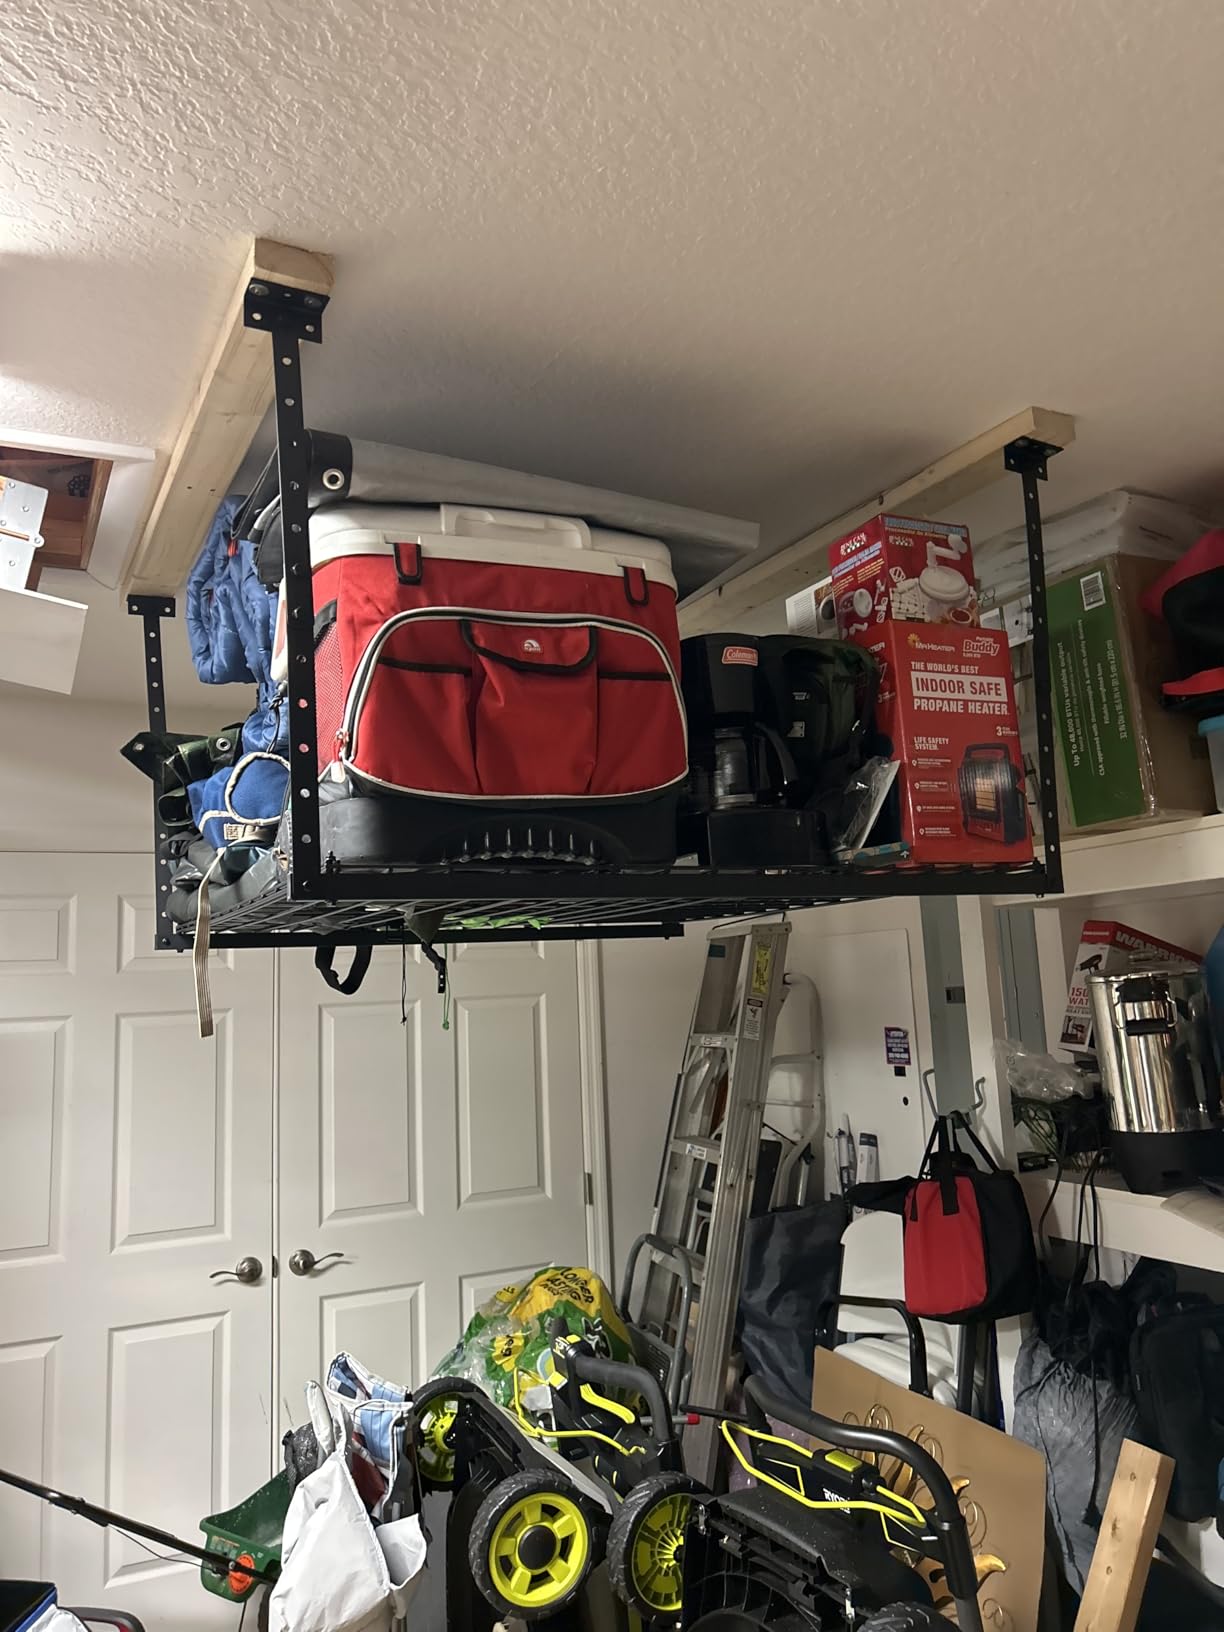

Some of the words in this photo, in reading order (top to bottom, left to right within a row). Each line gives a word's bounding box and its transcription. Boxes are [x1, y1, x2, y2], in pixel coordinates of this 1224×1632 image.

[963, 640, 1000, 656] Buddy
[912, 662, 925, 670] THE
[927, 663, 958, 673] WORLD'S
[961, 666, 979, 674] BEST
[916, 677, 965, 694] INDOOR
[970, 681, 1002, 696] SAFE
[914, 698, 964, 713] PROPANE
[968, 702, 1008, 715] HEATER
[996, 726, 1002, 736] 3
[1067, 719, 1076, 742] 48,000
[1072, 744, 1077, 754] To
[1073, 754, 1080, 766] Up
[560, 1268, 594, 1303] LONGER
